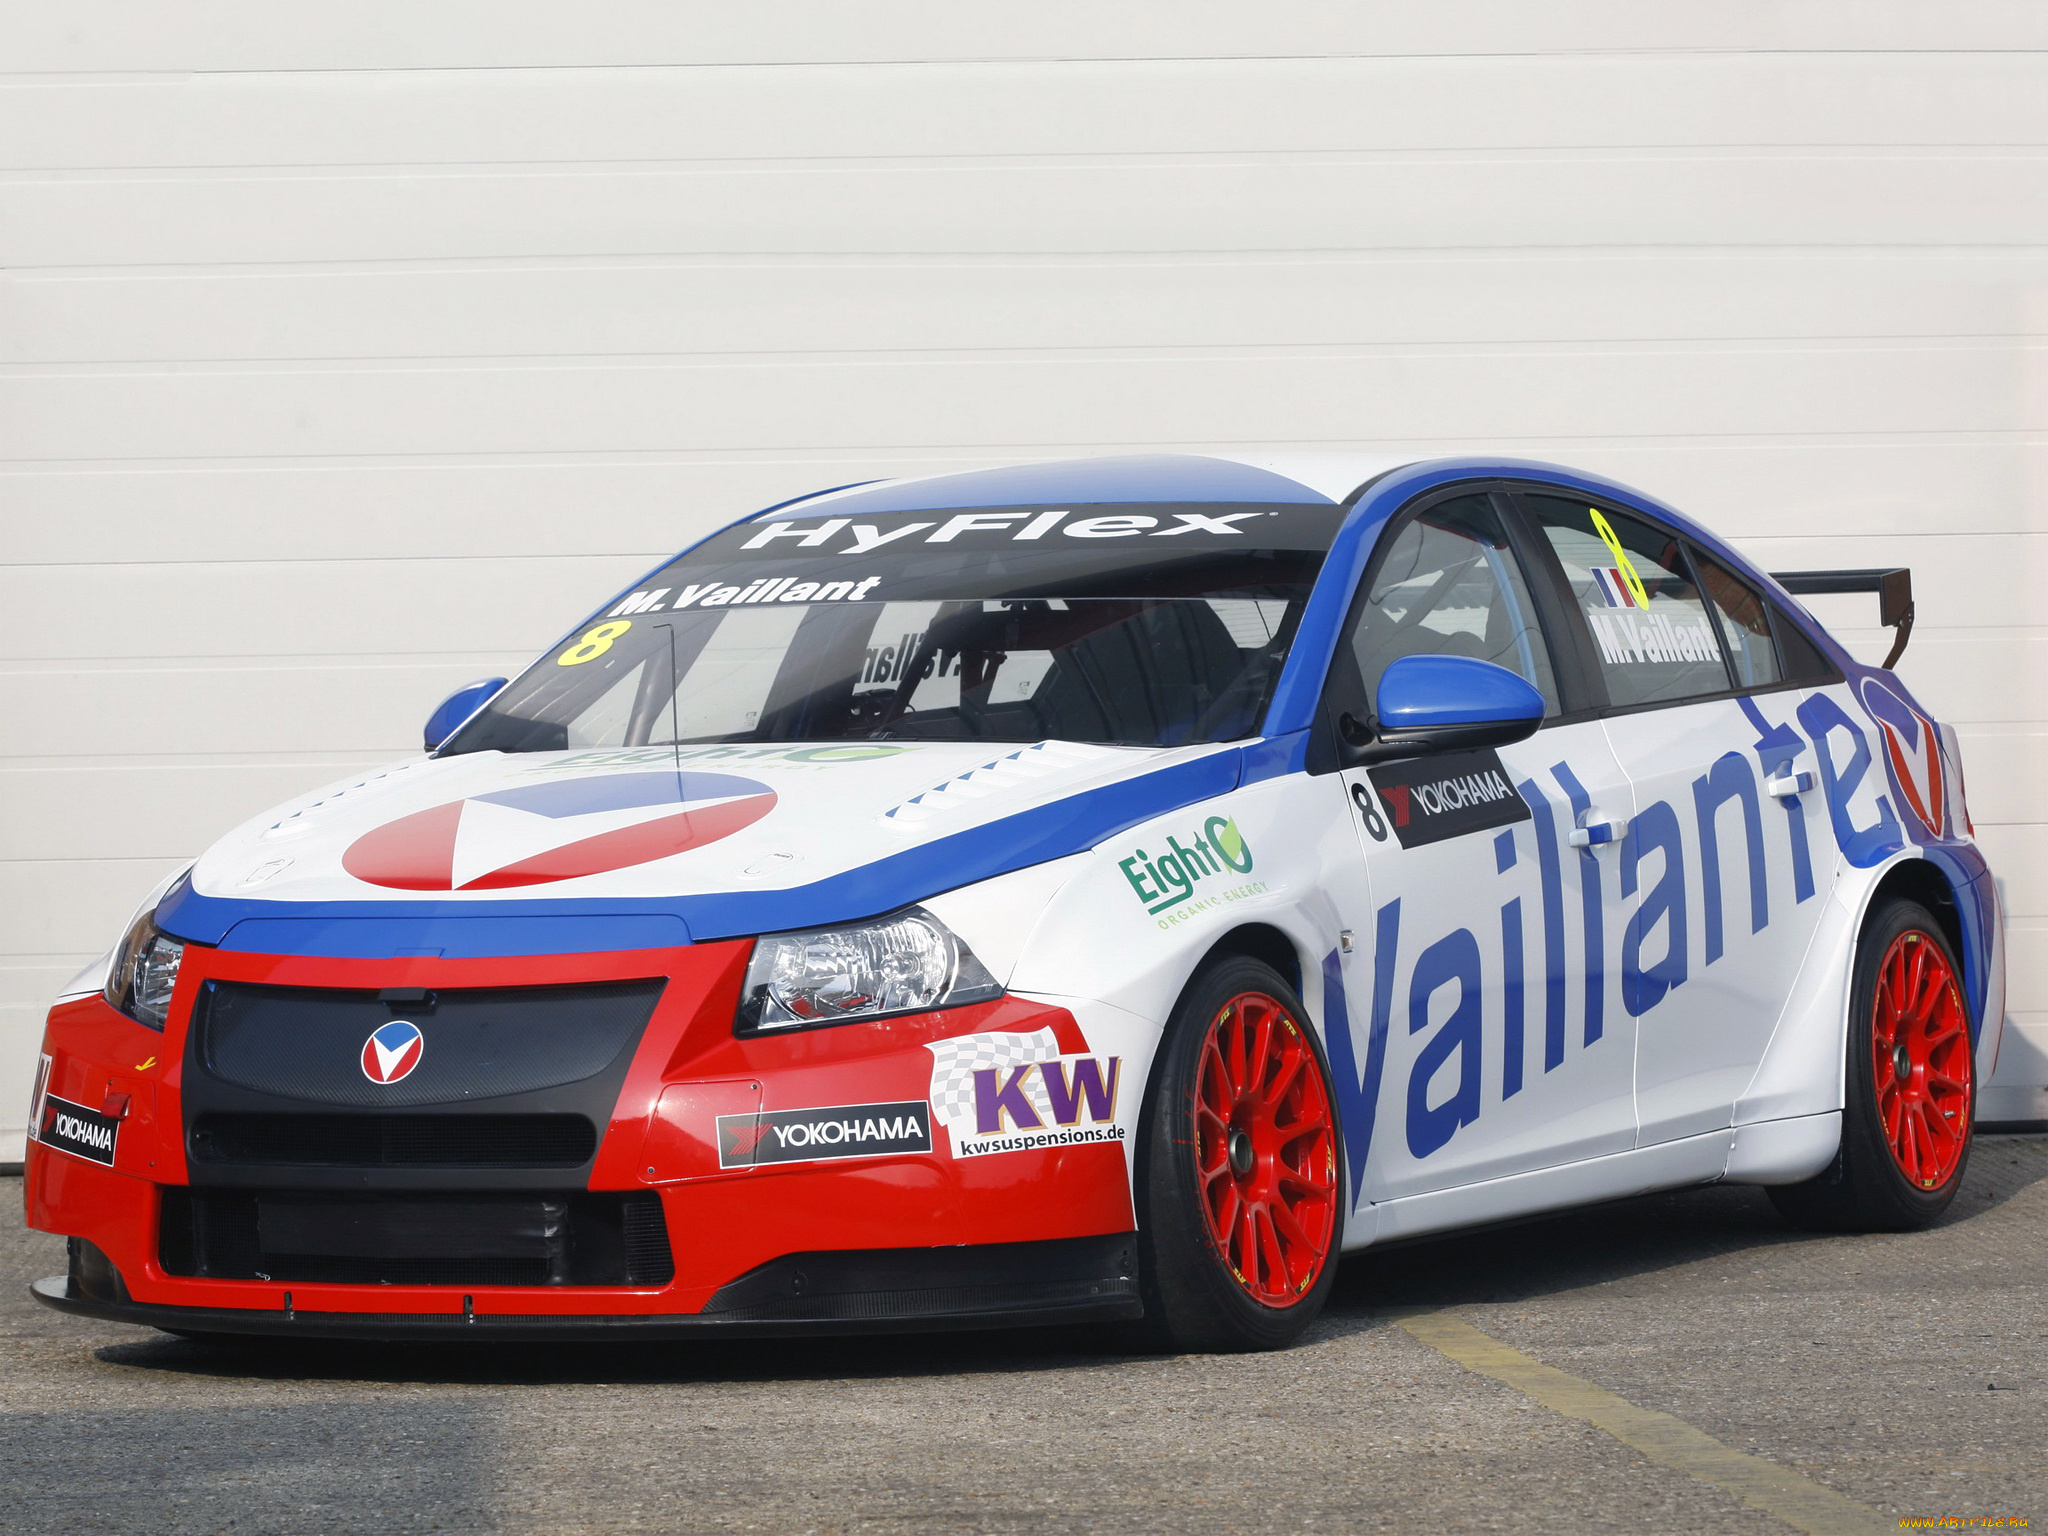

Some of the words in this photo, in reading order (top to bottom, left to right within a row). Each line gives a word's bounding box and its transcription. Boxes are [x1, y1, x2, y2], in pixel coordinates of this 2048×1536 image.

[740, 511, 1264, 554] HyFlex
[1589, 508, 1650, 611] 8
[607, 587, 672, 618] M.
[672, 576, 882, 609] Vaillant
[557, 620, 632, 666] 8
[1351, 782, 1389, 842] 8
[1410, 769, 1513, 816] YOKOHAMA
[1157, 896, 1223, 930] ORGANIC
[1223, 881, 1270, 902] ENERGY
[1324, 691, 1904, 1218] Vaillante
[972, 1056, 1123, 1136] KW
[56, 1112, 112, 1152] YOKOHAMA
[772, 1115, 924, 1148] YOKOHAMA
[960, 1125, 1126, 1156] kwsuspensions.de
